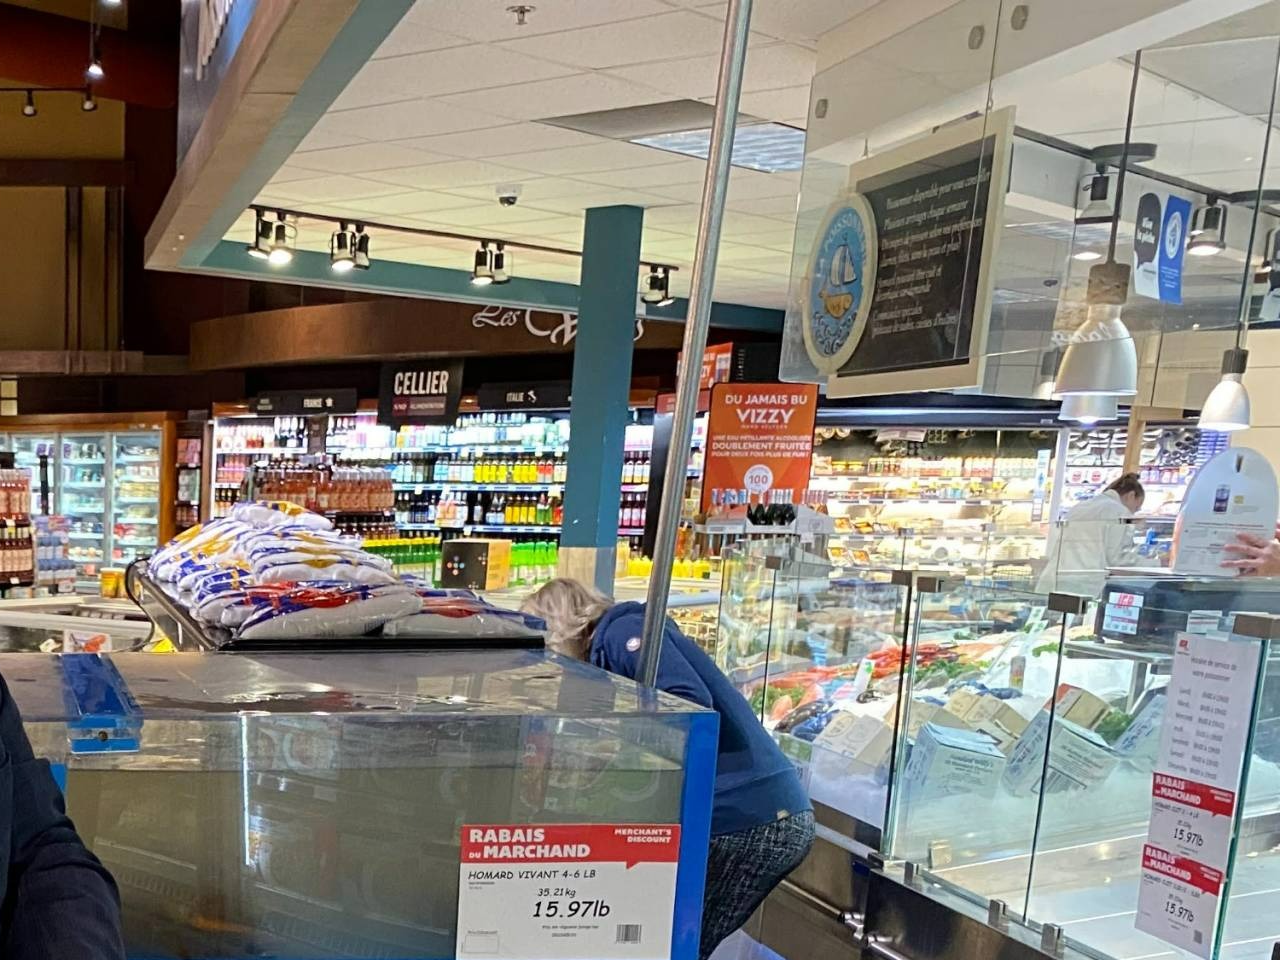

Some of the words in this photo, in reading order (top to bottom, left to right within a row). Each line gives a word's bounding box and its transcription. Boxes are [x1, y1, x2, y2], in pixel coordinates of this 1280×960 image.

[472, 303, 520, 327] Les
[394, 371, 449, 395] CELLIER
[725, 395, 742, 404] DU
[744, 395, 787, 405] JAMAIS
[790, 395, 808, 404] BU
[736, 408, 795, 424] VIZZY
[712, 442, 773, 450] DOUBLEMENT
[775, 441, 812, 450] FRUITÉE
[748, 475, 768, 484] 100
[1155, 775, 1185, 790] RABAIS
[1159, 788, 1201, 805] MARCHAND
[469, 828, 545, 843] RABAIS
[614, 828, 673, 836] MERCHANT'S
[483, 844, 591, 858] MARCHAND
[1145, 847, 1176, 864] RABAIS
[468, 871, 514, 880] HOMARD
[518, 870, 559, 879] VIVANT
[562, 870, 580, 878] 4-6
[583, 869, 596, 878] LB
[1148, 859, 1192, 881] MARCHAND
[537, 888, 576, 898] 35.21kg
[533, 900, 610, 918] 15.97lb
